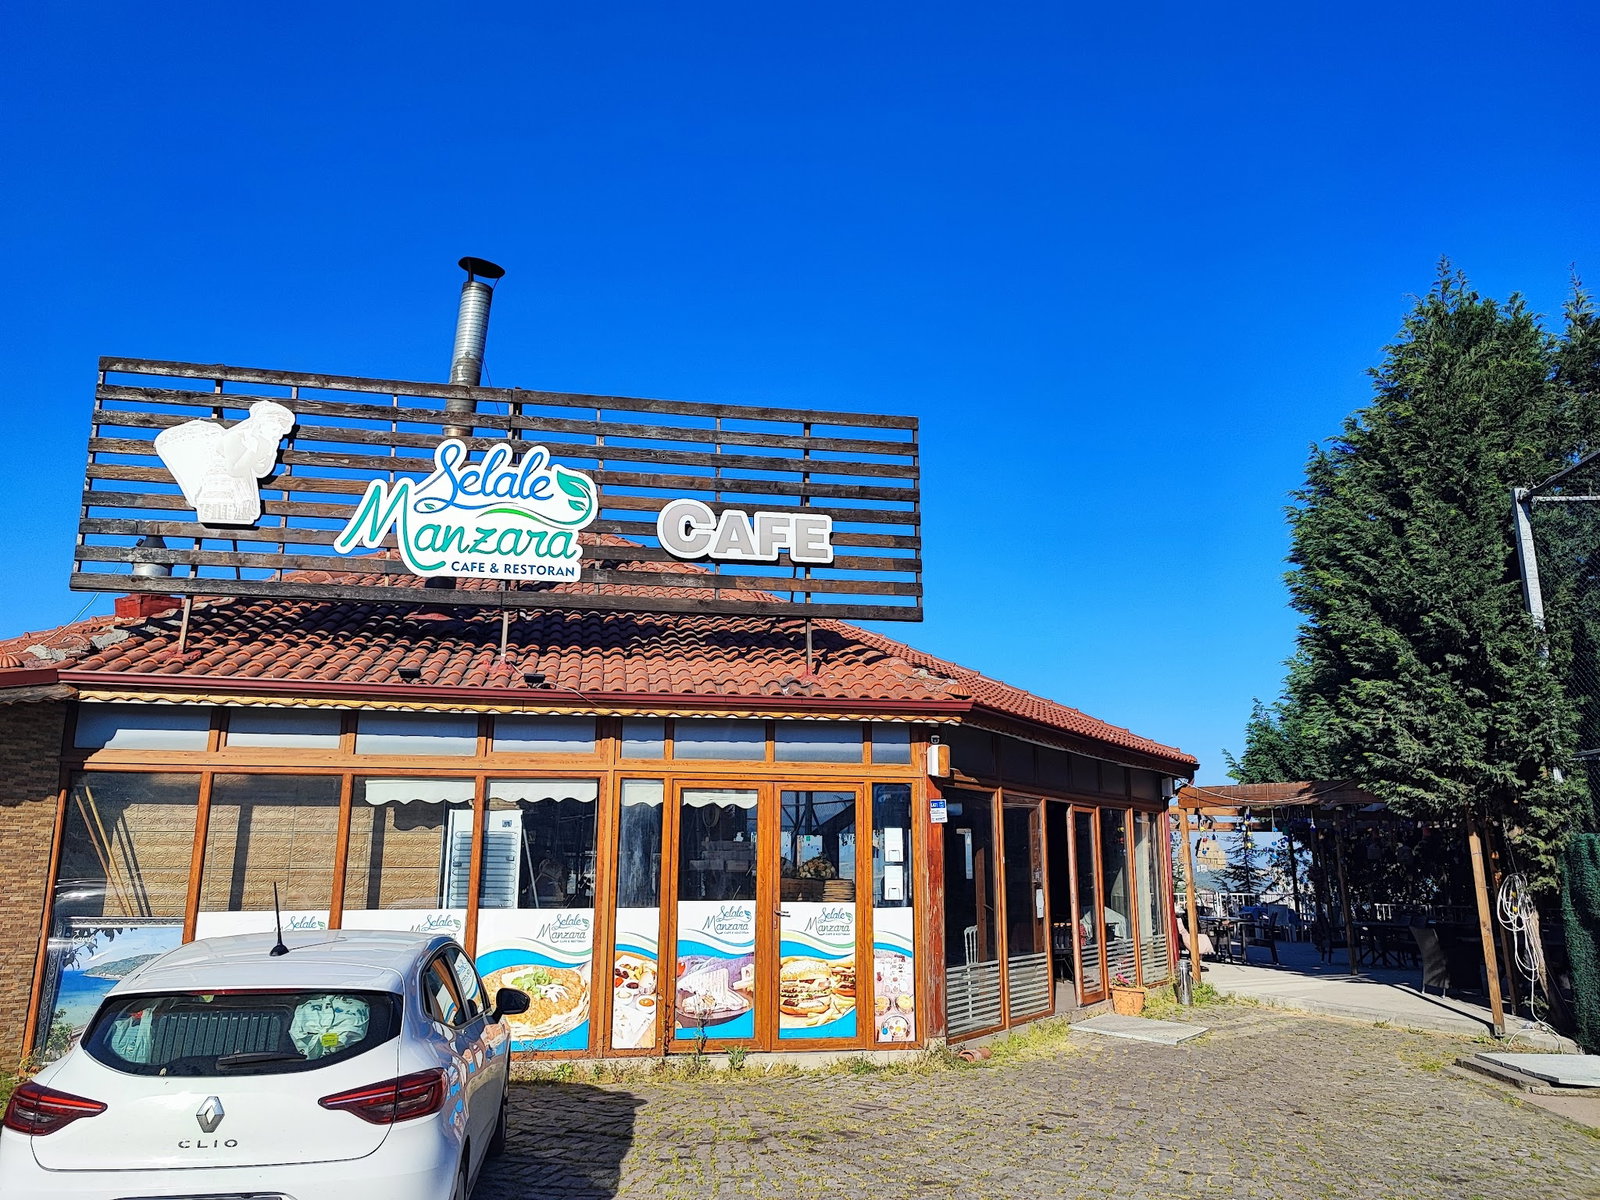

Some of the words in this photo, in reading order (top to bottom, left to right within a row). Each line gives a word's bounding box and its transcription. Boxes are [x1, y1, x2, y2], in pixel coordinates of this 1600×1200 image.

[414, 444, 554, 509] Selale
[340, 483, 577, 571] Manzara
[662, 503, 828, 558] CAFE
[451, 561, 485, 574] CAFE
[490, 564, 499, 574] &
[504, 564, 575, 577] RESTORAN
[536, 923, 586, 943] Manzara
[702, 915, 749, 934] Manzara
[804, 916, 850, 935] Manzara
[178, 1139, 238, 1149] CLIO
